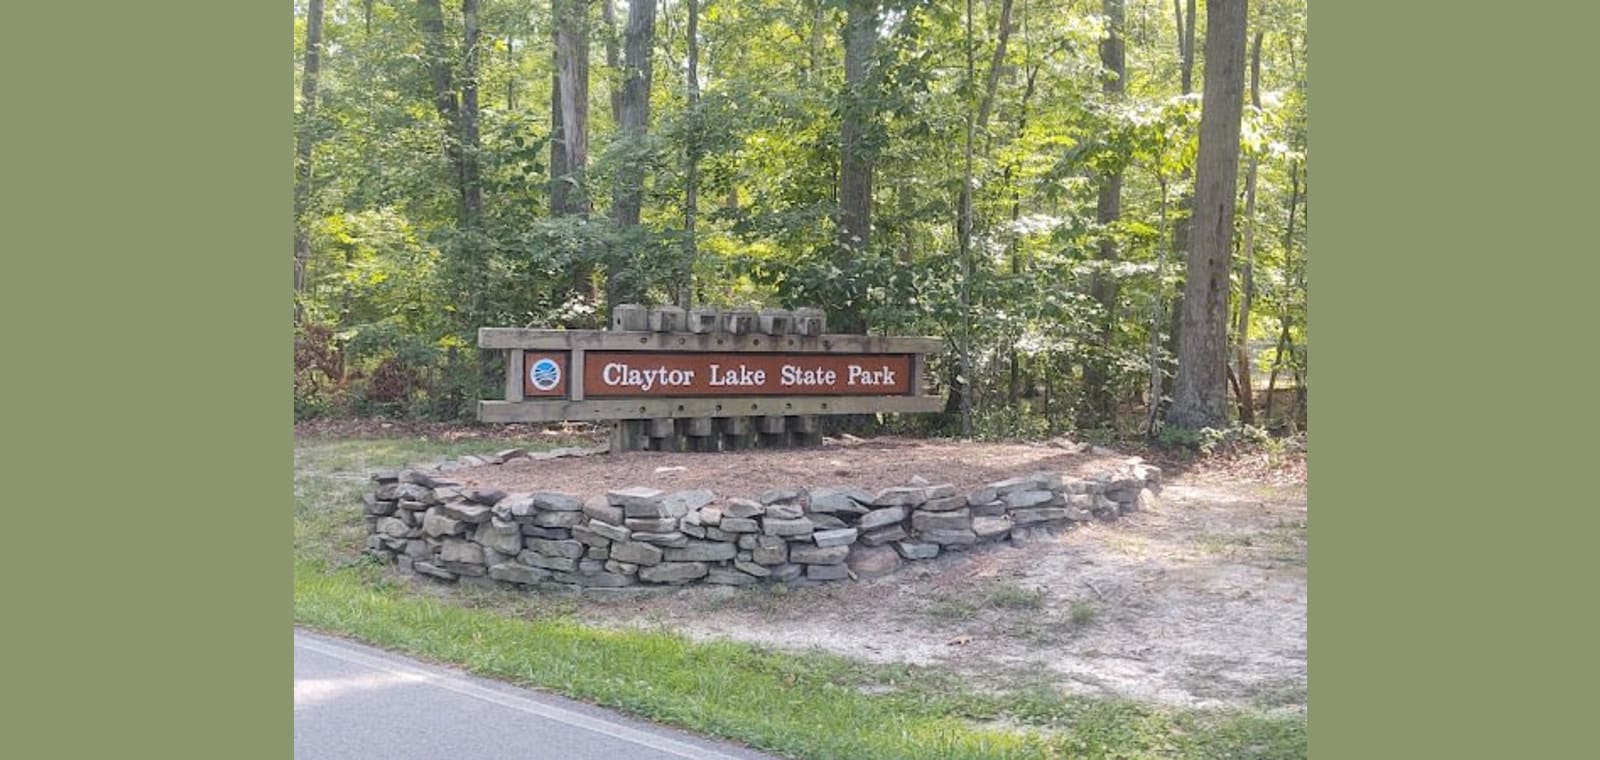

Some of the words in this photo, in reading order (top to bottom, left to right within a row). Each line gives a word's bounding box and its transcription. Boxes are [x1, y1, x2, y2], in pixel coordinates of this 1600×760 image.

[602, 362, 695, 392] Claytor
[708, 364, 766, 387] Lake
[780, 364, 837, 387] State
[847, 364, 896, 386] Park
